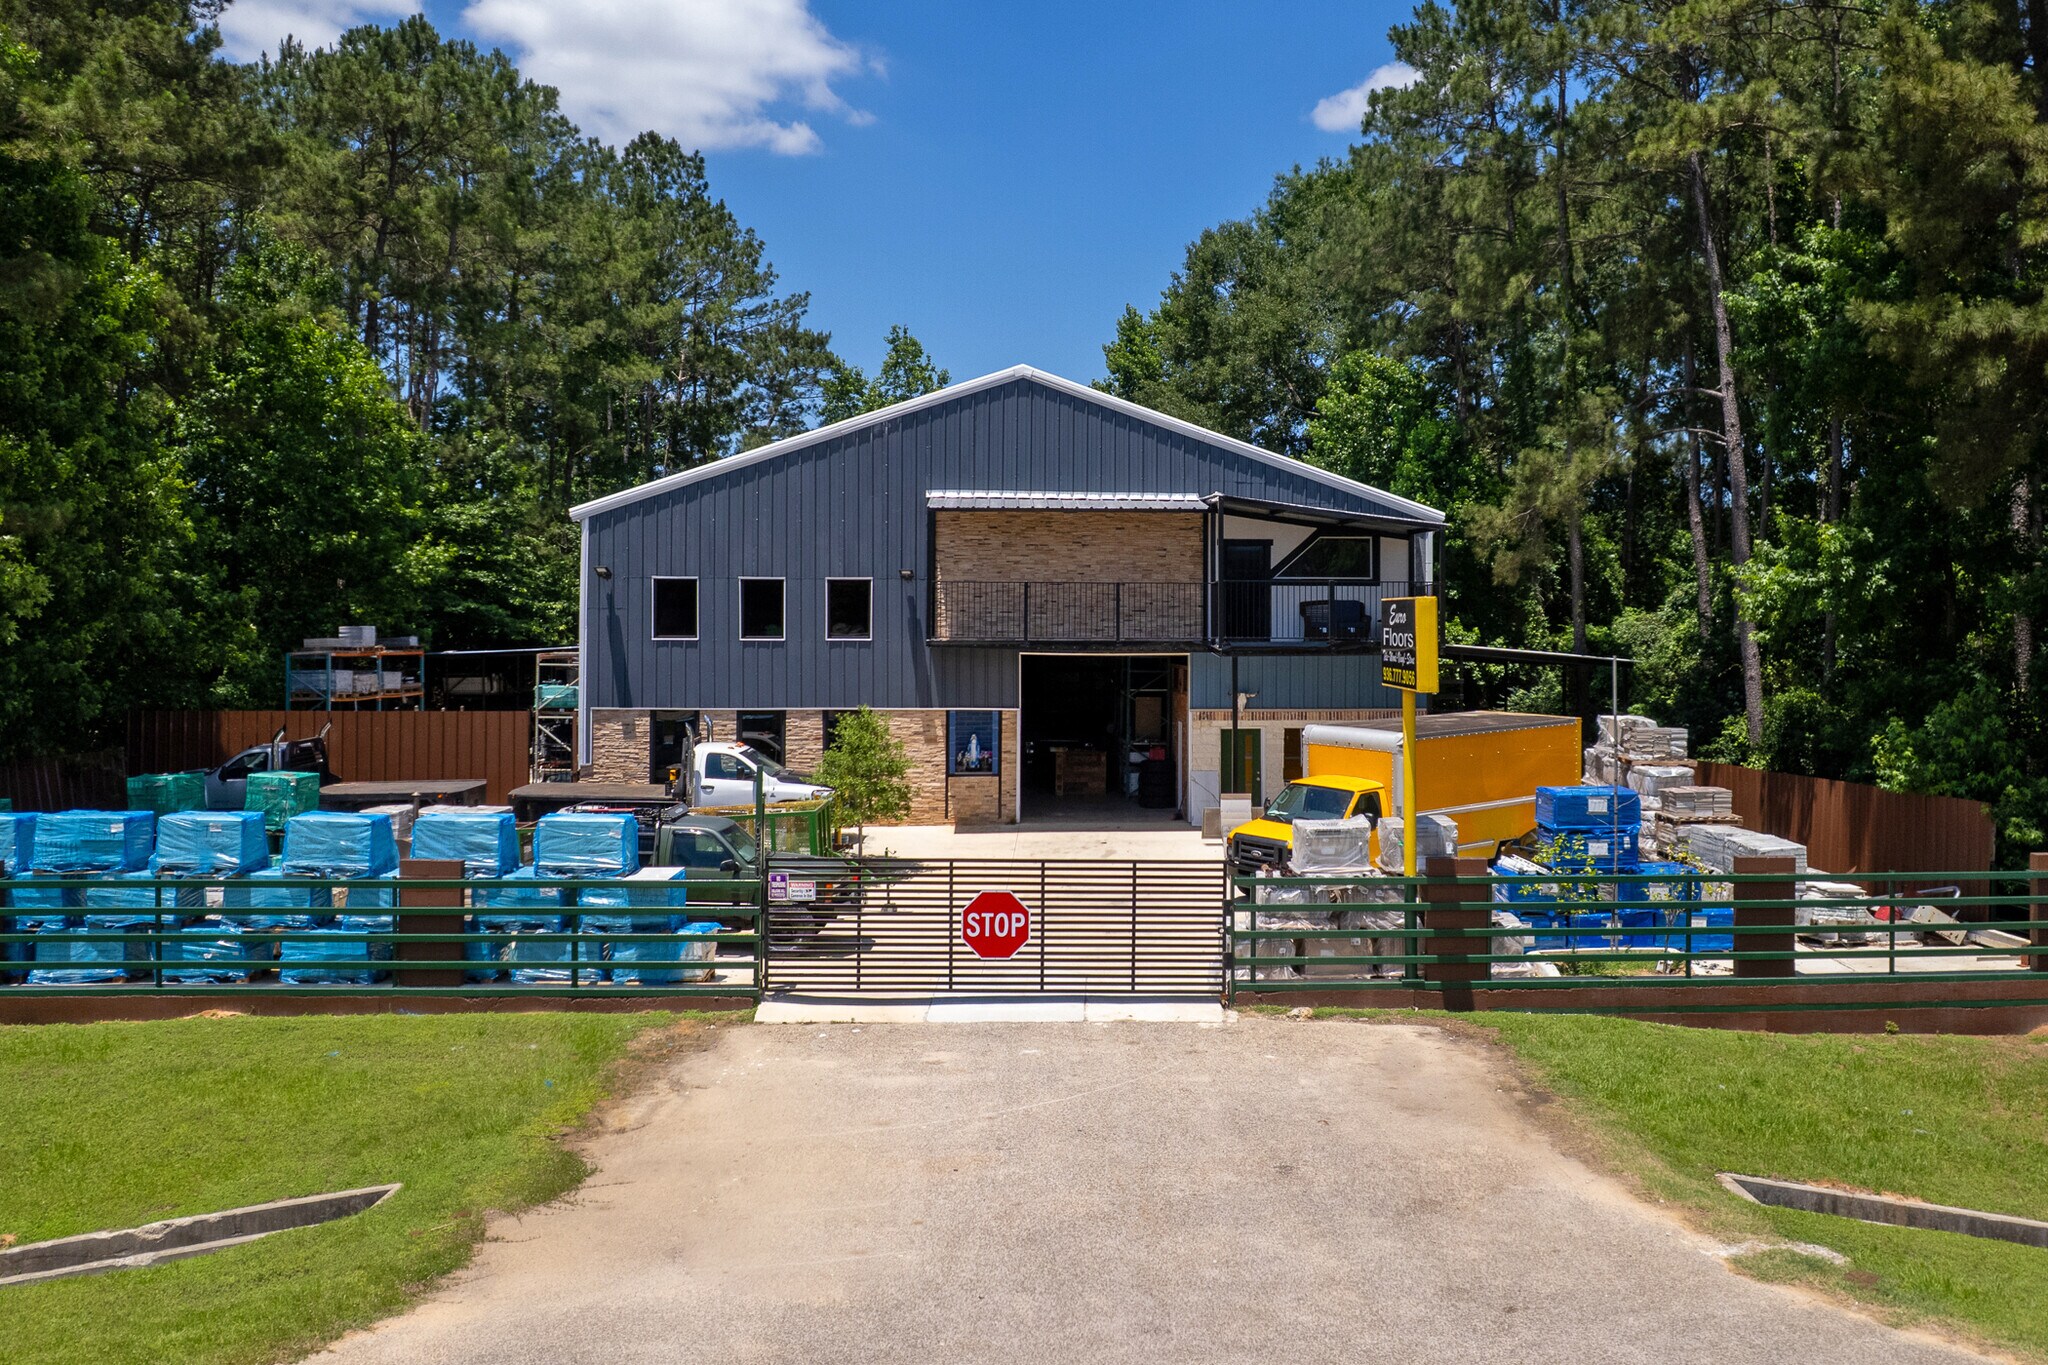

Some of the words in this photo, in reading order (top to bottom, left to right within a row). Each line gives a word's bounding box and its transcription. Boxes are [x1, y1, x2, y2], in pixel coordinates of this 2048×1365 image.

[1389, 604, 1407, 626] Euro
[1383, 628, 1414, 648] Floors
[966, 912, 1026, 938] STOP
